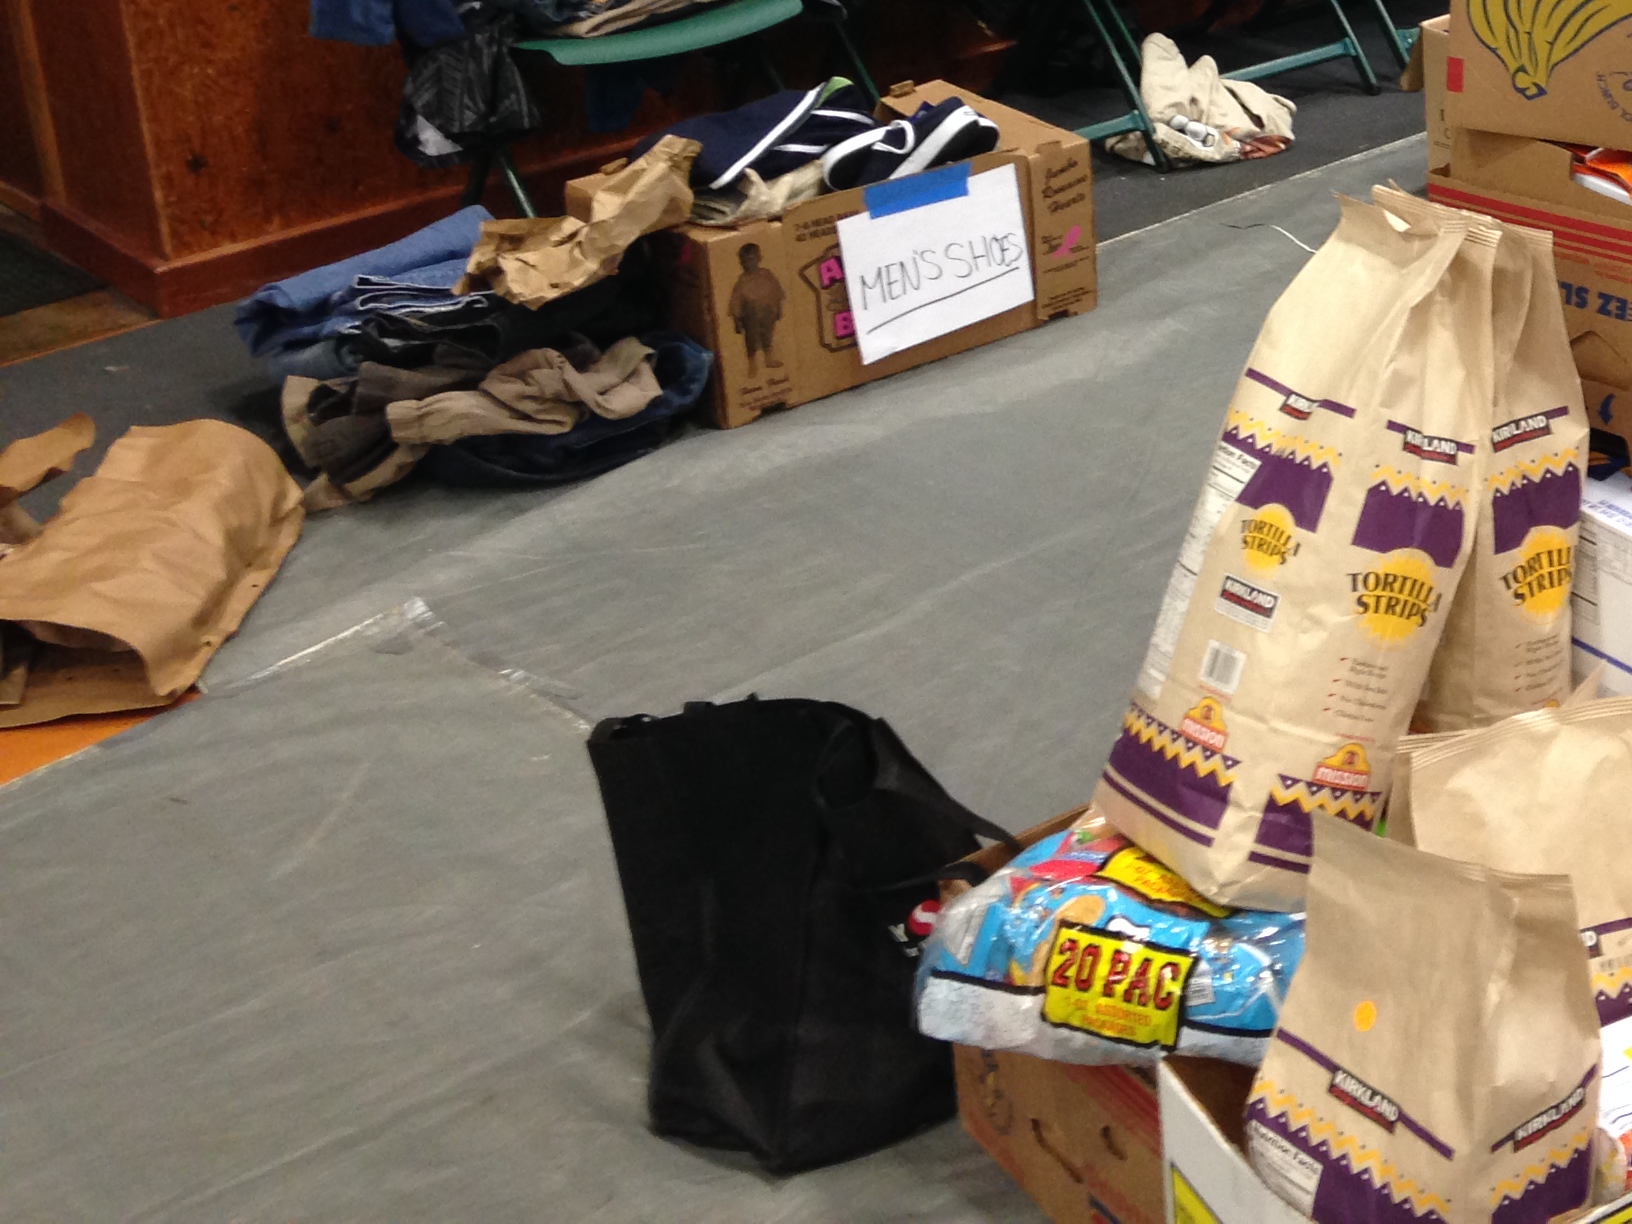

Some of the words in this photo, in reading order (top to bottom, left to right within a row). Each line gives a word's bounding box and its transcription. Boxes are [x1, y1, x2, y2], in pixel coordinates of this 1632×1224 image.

[860, 249, 943, 311] MEN'S
[944, 232, 1024, 278] SHOES
[1406, 429, 1458, 456] KIRLAND
[1493, 414, 1548, 443] KIRLAND
[1241, 534, 1288, 566] STRIPS
[1346, 570, 1443, 613] TORTILLA
[1356, 594, 1429, 627] STRIPS
[1051, 938, 1102, 992] 20
[1334, 1069, 1400, 1122] KIRKLAND
[1514, 1086, 1585, 1141] KIRKLAND
